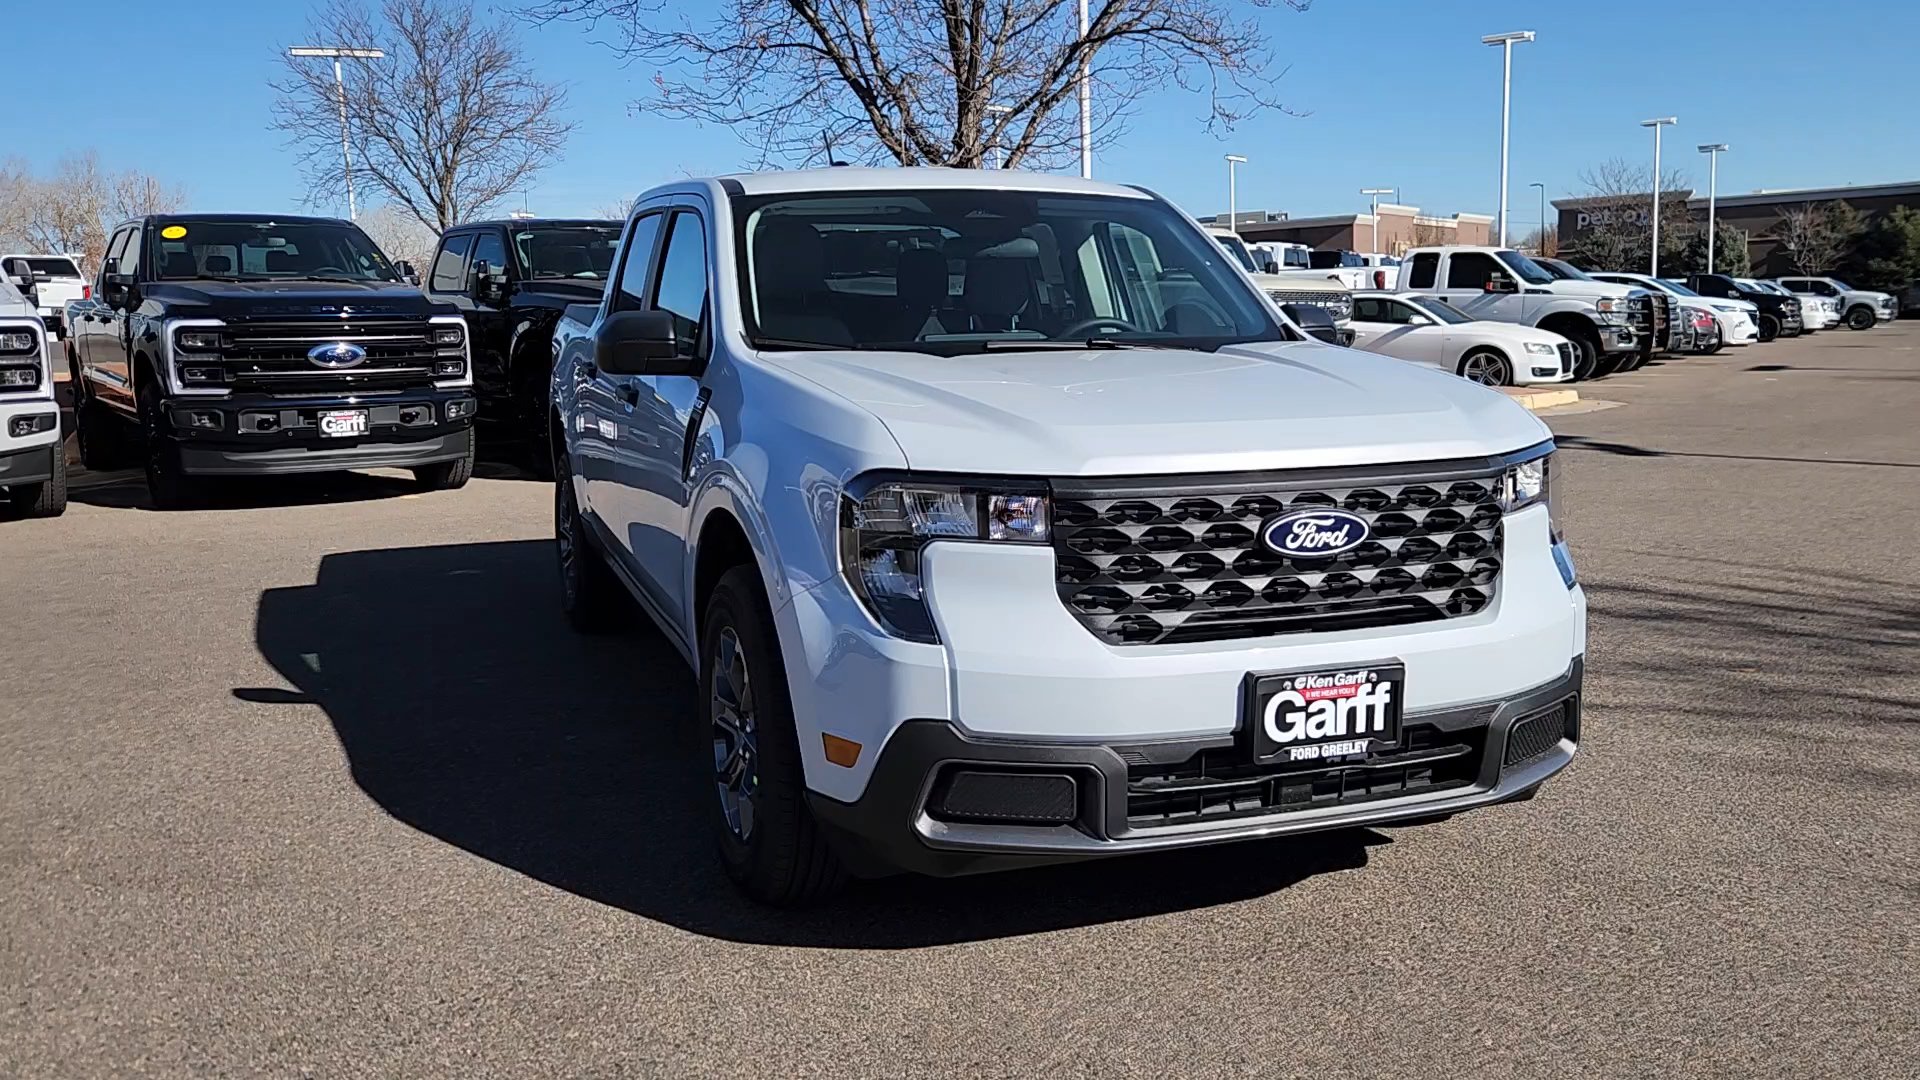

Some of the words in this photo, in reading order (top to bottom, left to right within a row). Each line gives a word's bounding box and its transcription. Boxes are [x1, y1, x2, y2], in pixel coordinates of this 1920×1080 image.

[1577, 208, 1637, 230] peto
[321, 415, 365, 433] Garff
[1285, 518, 1350, 549] Ford
[1307, 676, 1333, 689] Ken
[1334, 671, 1369, 686] Garff
[1264, 682, 1391, 743] Garff
[1290, 746, 1319, 760] FORD
[1321, 740, 1369, 757] GREELEY
